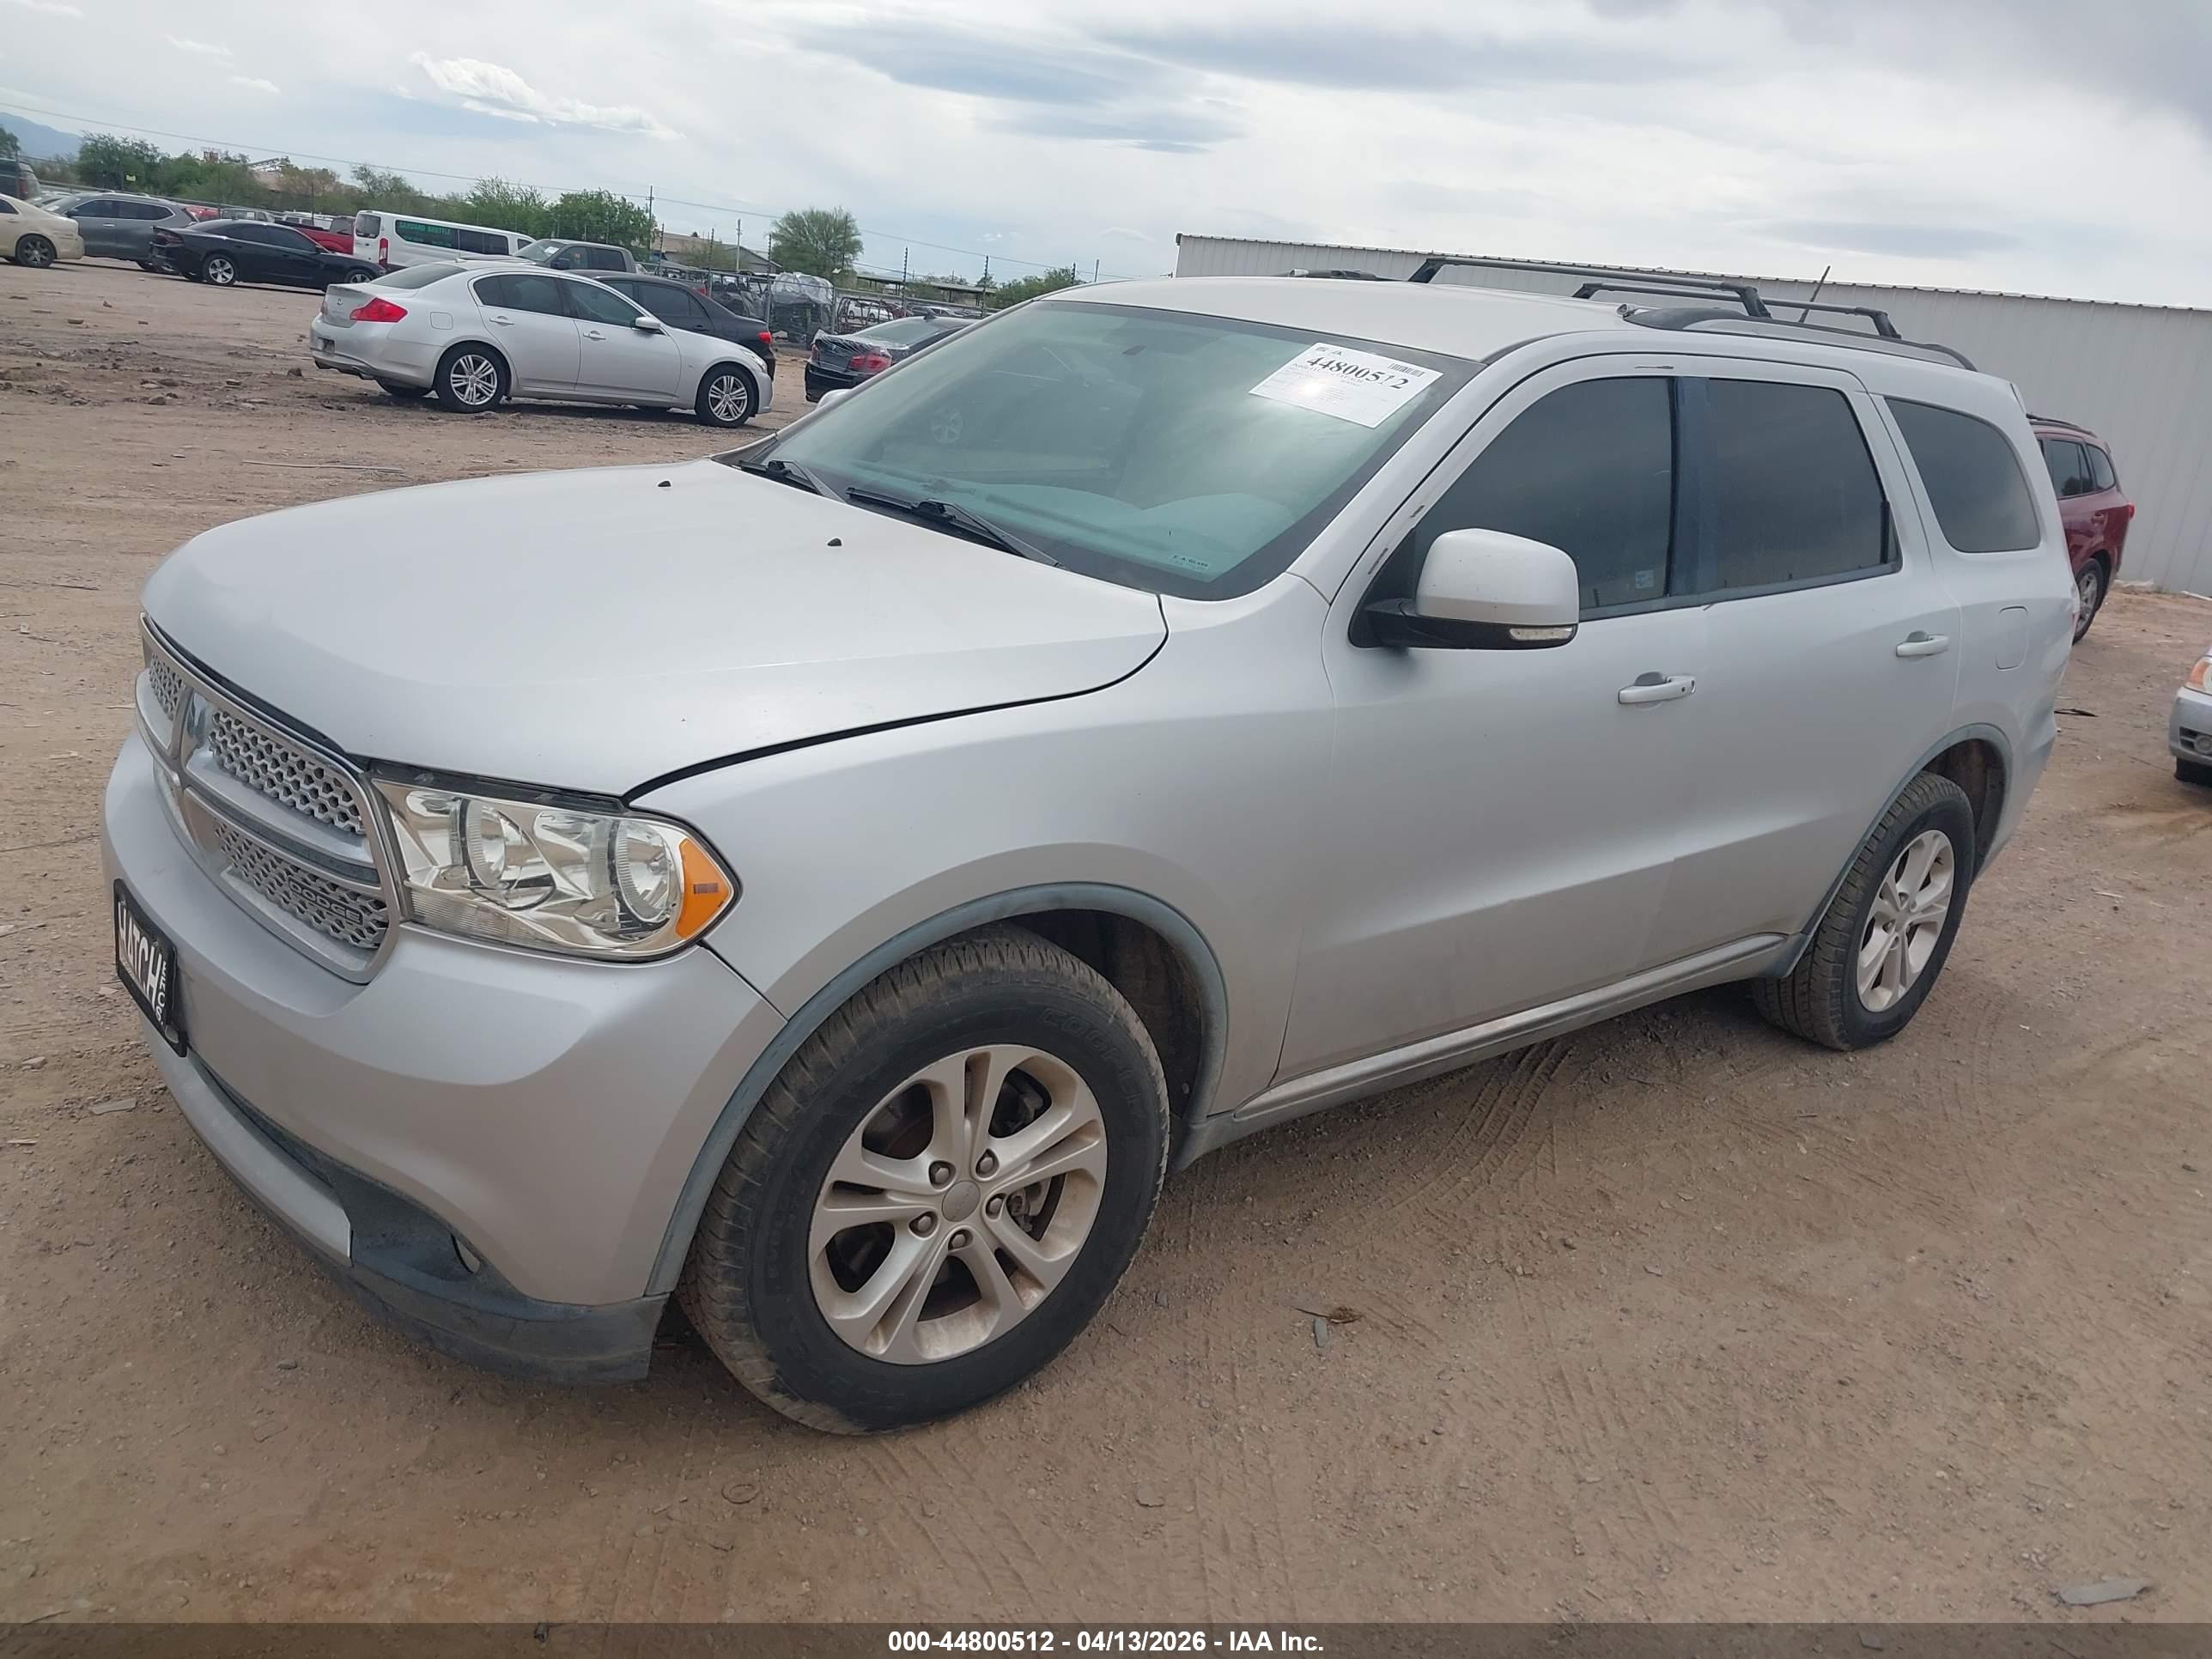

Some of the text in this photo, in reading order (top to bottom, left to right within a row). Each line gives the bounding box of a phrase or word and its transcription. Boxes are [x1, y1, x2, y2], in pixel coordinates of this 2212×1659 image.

[1306, 356, 1410, 390] 44800512
[289, 880, 361, 924] DODGE
[118, 901, 162, 1012] HATCH
